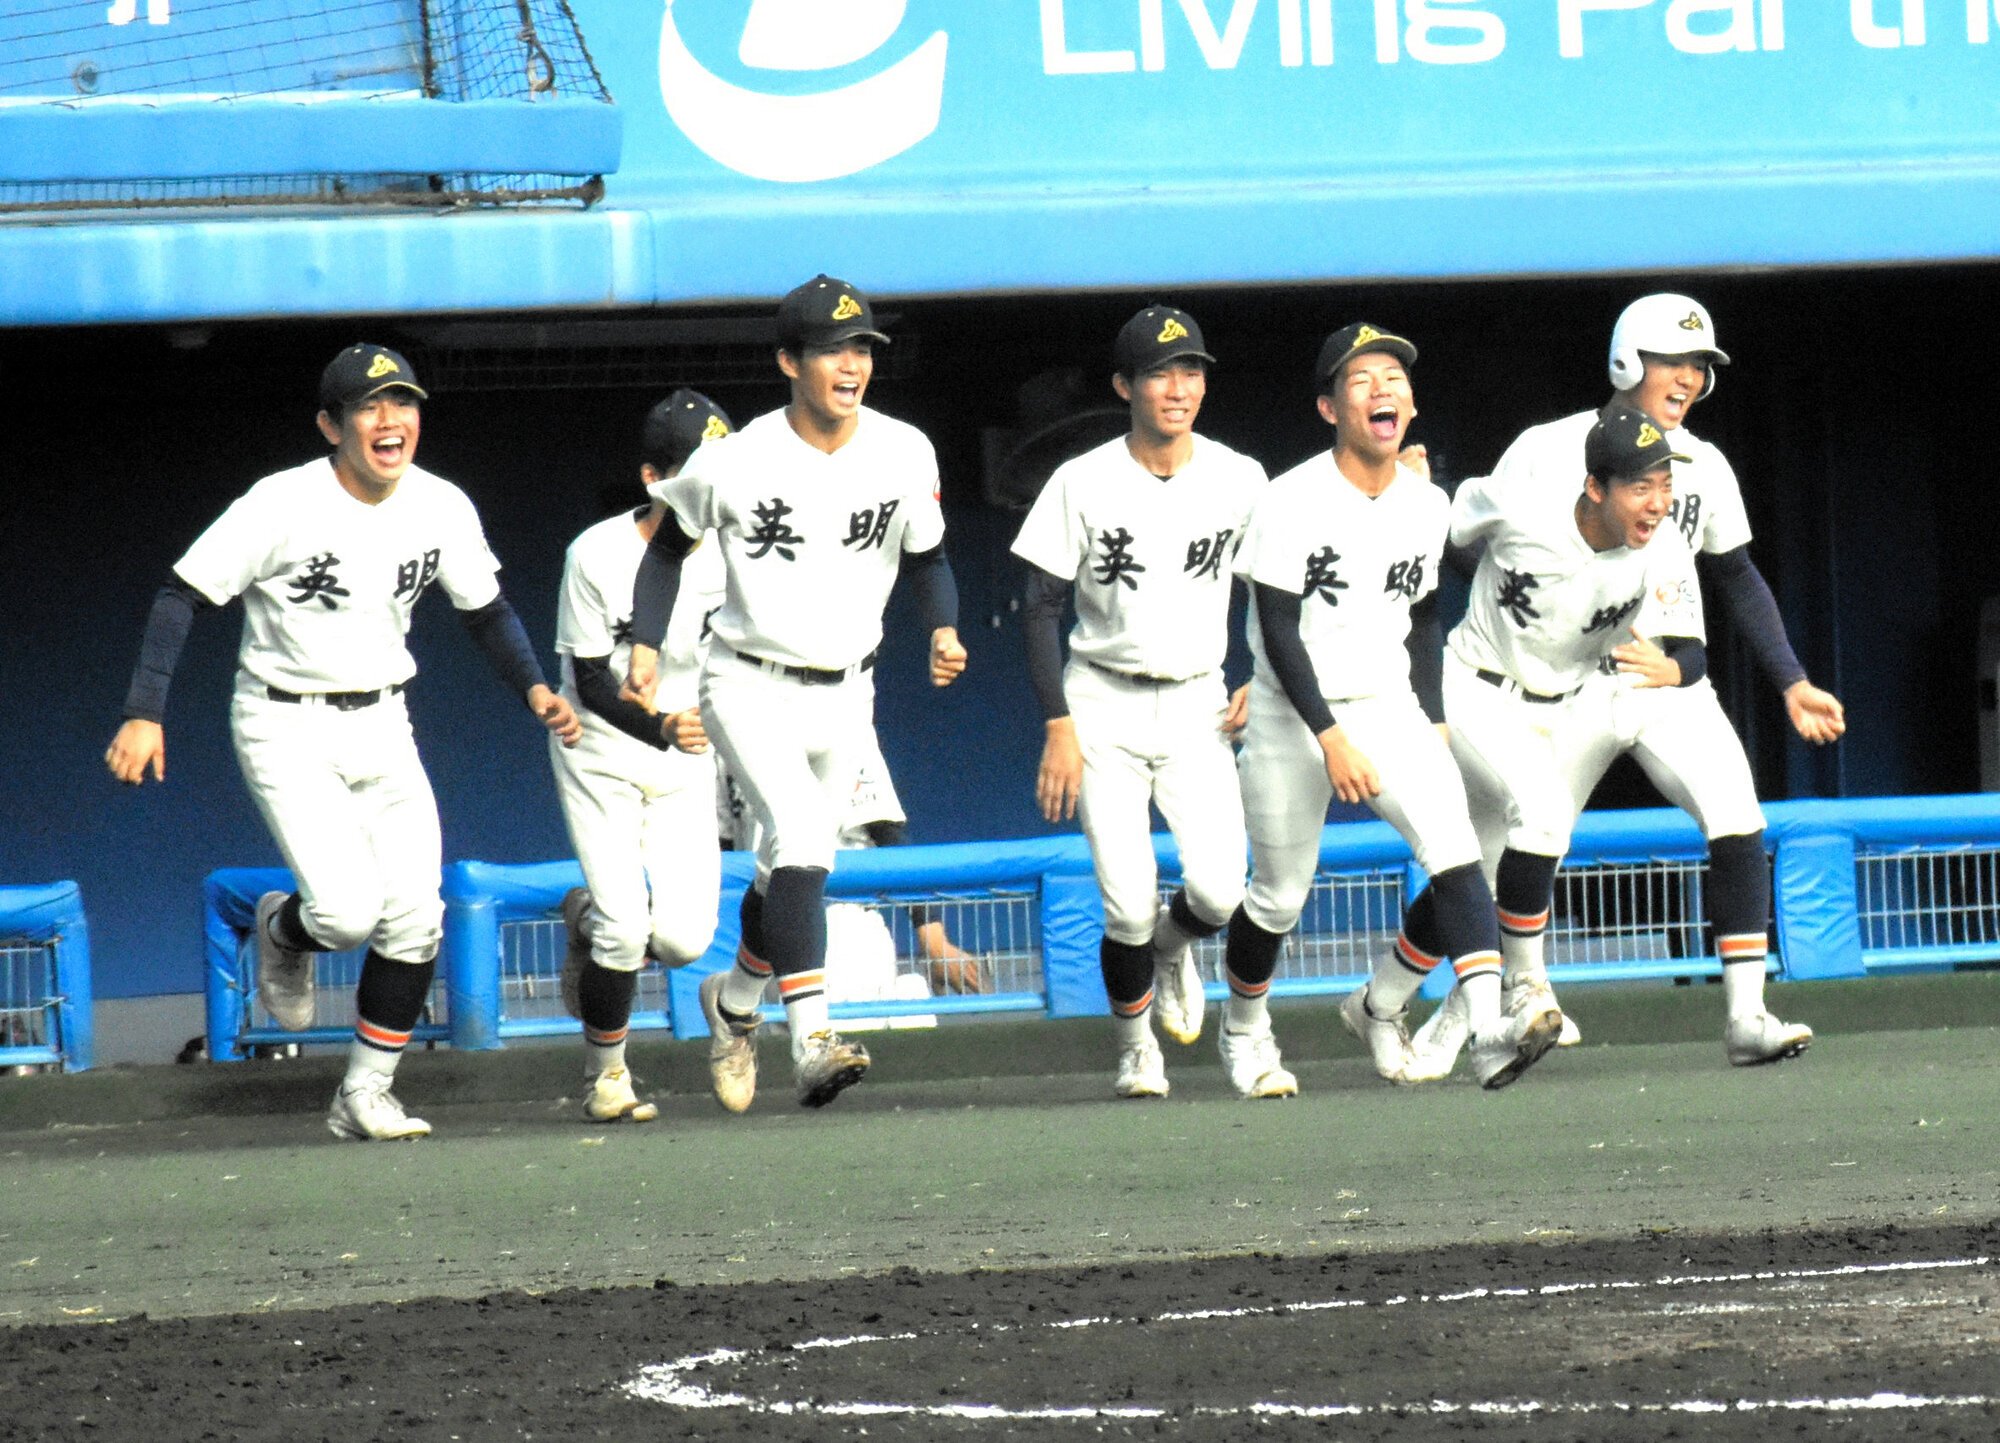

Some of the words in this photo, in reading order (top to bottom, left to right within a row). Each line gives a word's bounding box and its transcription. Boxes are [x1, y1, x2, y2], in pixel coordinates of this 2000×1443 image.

[744, 498, 900, 562] 英明
[1094, 527, 1234, 590] 英明
[287, 548, 441, 610] 英明
